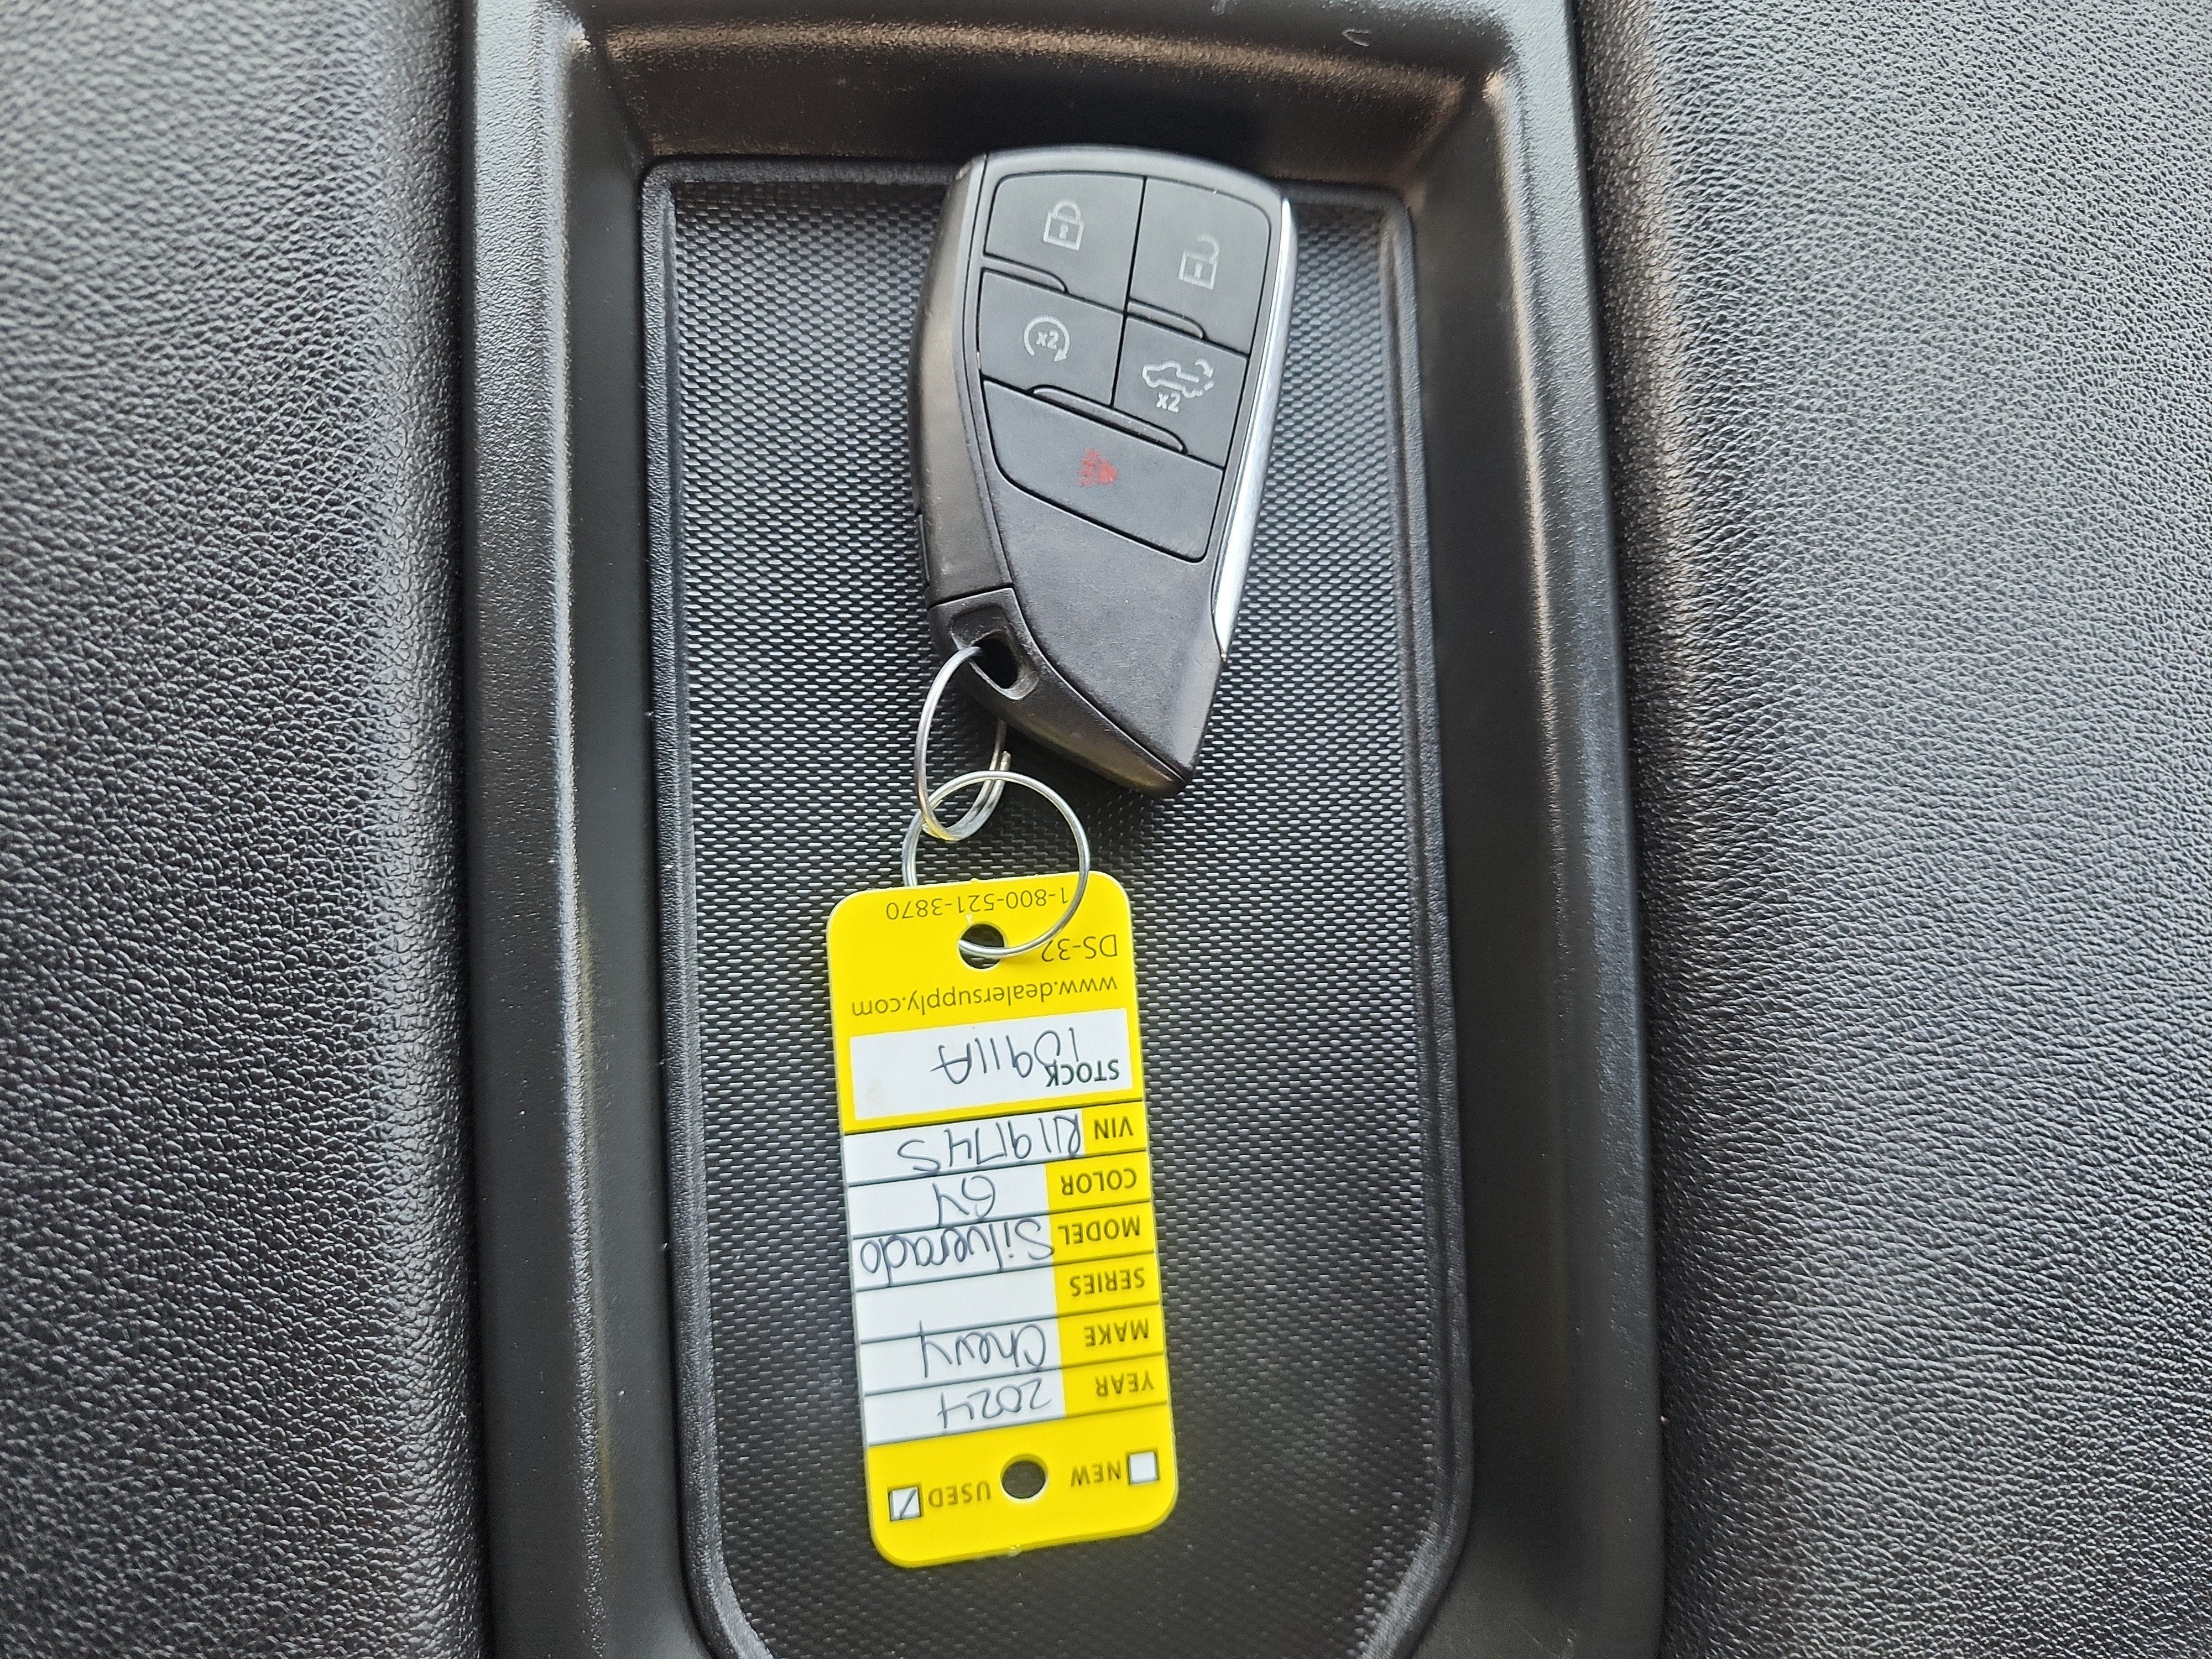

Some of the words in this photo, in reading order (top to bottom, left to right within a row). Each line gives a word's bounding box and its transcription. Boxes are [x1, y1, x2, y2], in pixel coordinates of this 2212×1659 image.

[886, 888, 1068, 920] 1-800-521-3870
[1041, 934, 1118, 962] DS-32
[851, 976, 1118, 1016] www.dealersupply.com
[930, 1026, 1079, 1084] 10911A
[1045, 1058, 1120, 1088] STOCK
[1093, 1116, 1134, 1140] VIN
[1060, 1167, 1137, 1196] COLOR
[1057, 1214, 1141, 1246] MODEL
[859, 1217, 1055, 1288] Silverado
[1069, 1267, 1145, 1297] SERIES
[1084, 1317, 1150, 1348] MAKE
[919, 1319, 1046, 1378] Chevy
[1095, 1369, 1155, 1397] YEAR
[937, 1376, 1052, 1430] 2024
[1070, 1459, 1122, 1488] NEW
[928, 1480, 992, 1508] USED
